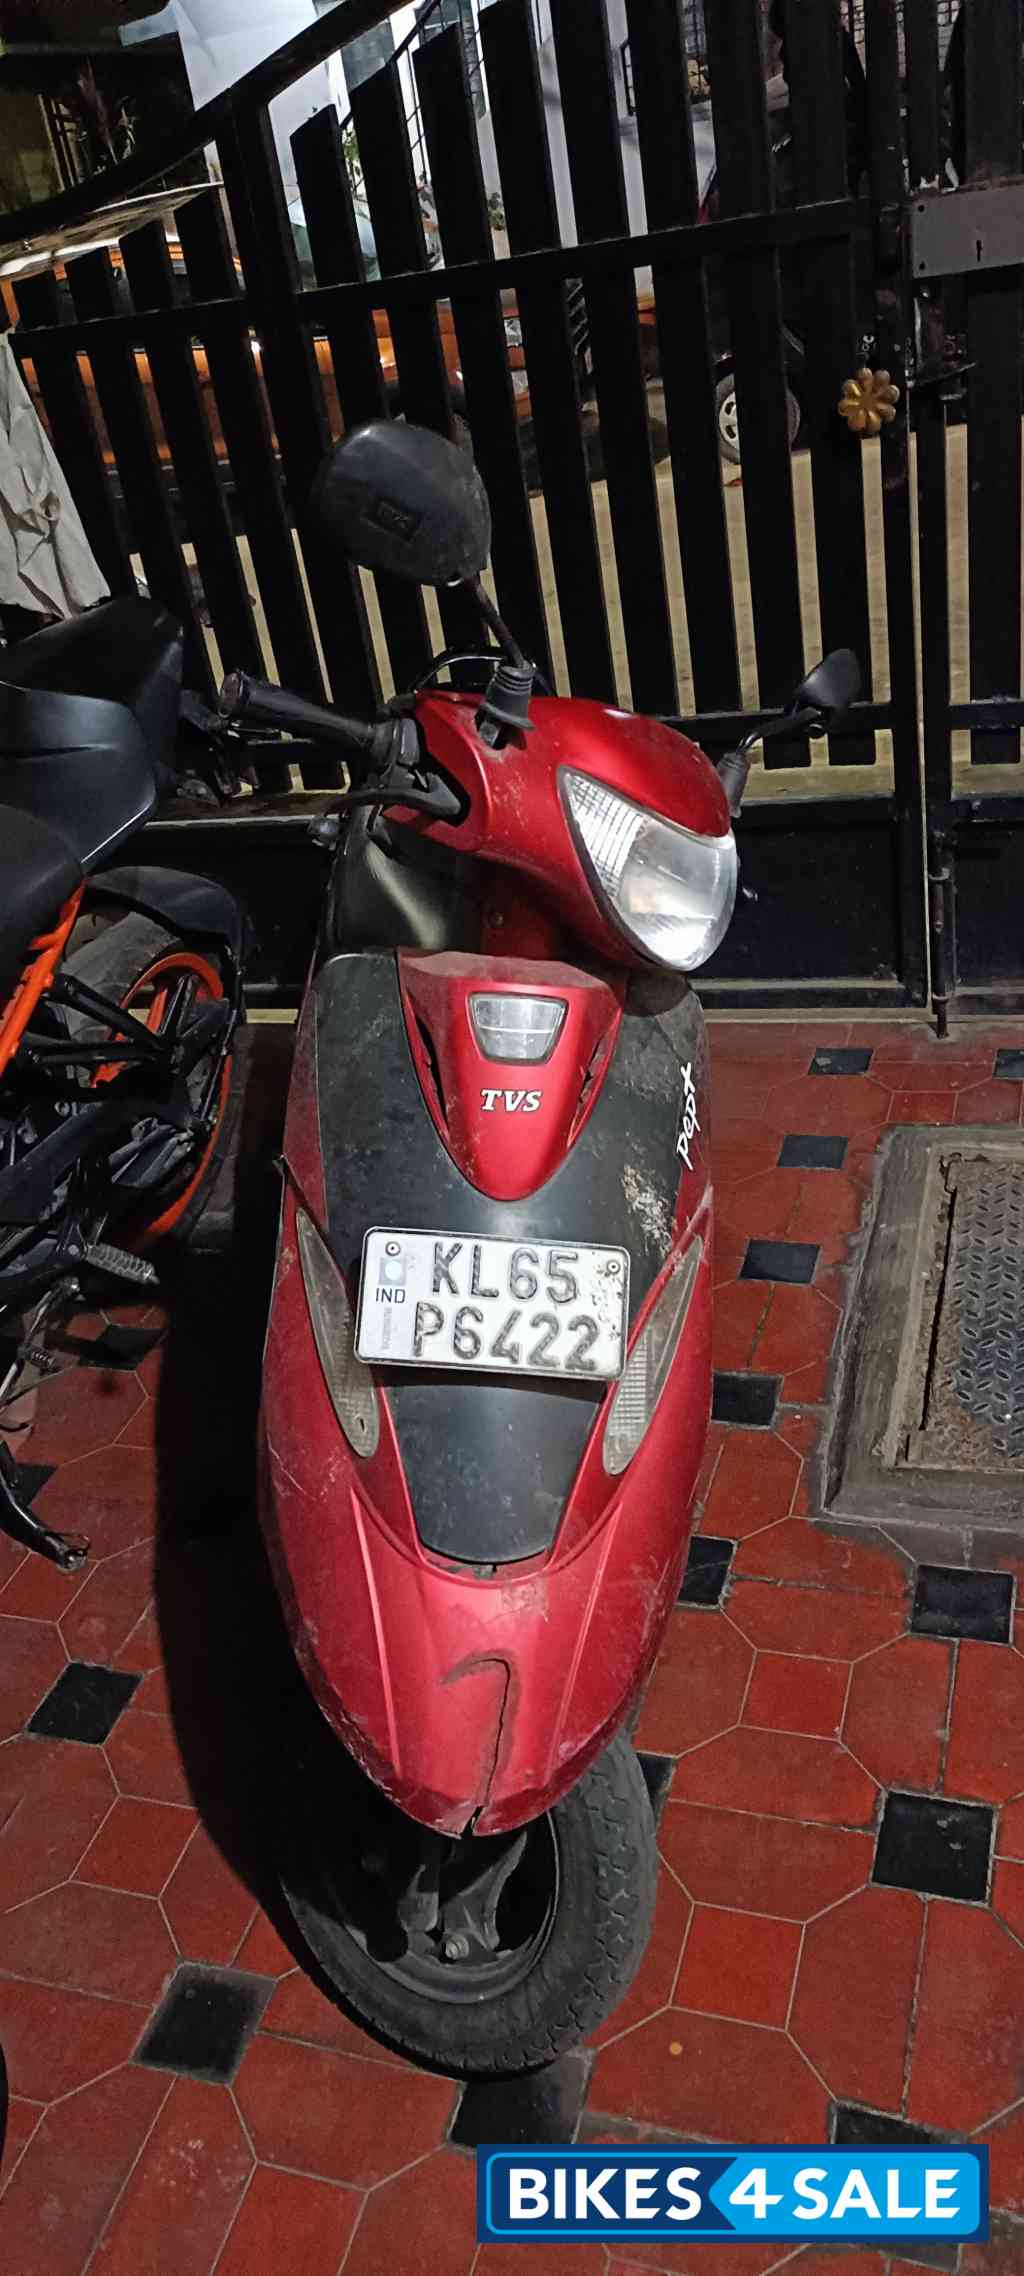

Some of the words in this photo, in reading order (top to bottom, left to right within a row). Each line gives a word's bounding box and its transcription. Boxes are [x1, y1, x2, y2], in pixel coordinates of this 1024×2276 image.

[481, 1089, 543, 1113] TVS
[432, 1241, 579, 1304] KL65
[375, 1288, 406, 1304] IND
[413, 1301, 600, 1372] P6422
